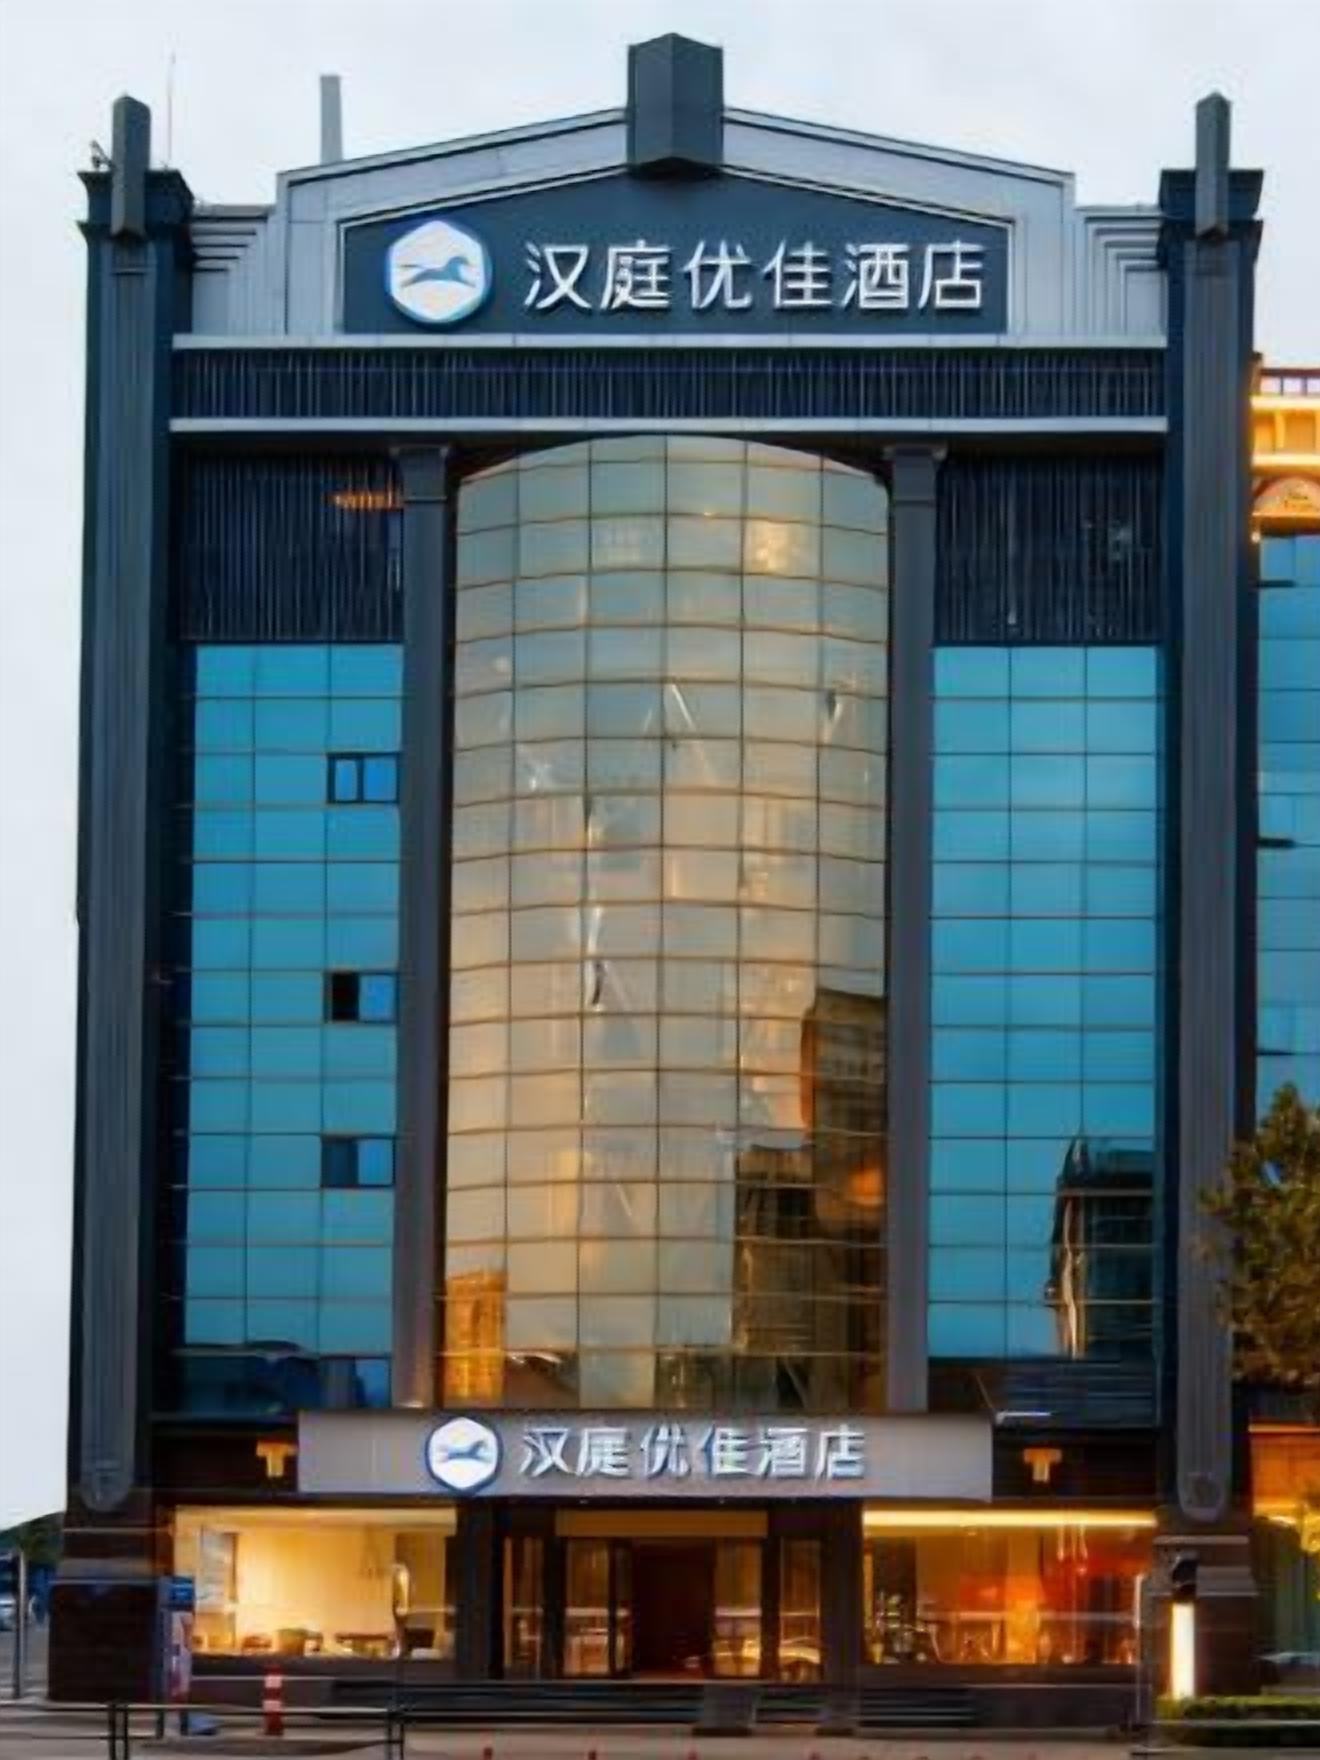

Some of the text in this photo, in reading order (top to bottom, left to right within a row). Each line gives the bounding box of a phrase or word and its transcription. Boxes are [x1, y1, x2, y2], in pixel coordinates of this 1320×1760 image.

[523, 239, 986, 311] 汉庭优佳酒店
[519, 1424, 866, 1479] 汉庭优佳酒店
